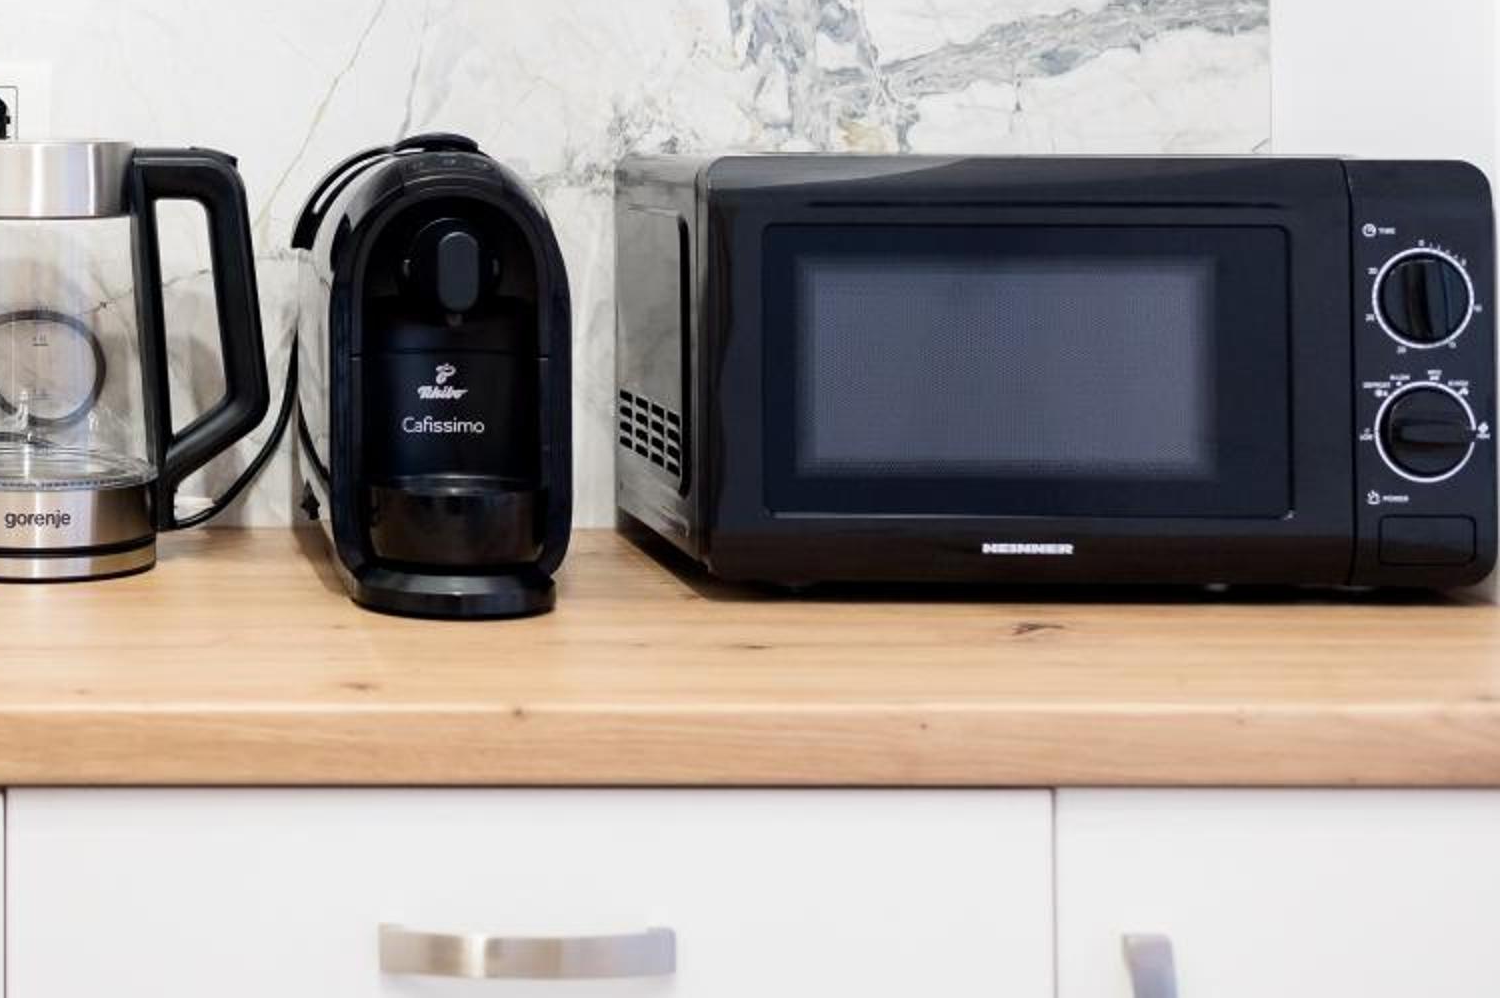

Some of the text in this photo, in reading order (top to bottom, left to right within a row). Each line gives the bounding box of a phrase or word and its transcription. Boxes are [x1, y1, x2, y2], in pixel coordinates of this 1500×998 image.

[417, 385, 468, 400] Tchibo
[402, 416, 485, 433] Cafissimo
[4, 509, 71, 529] gorenje
